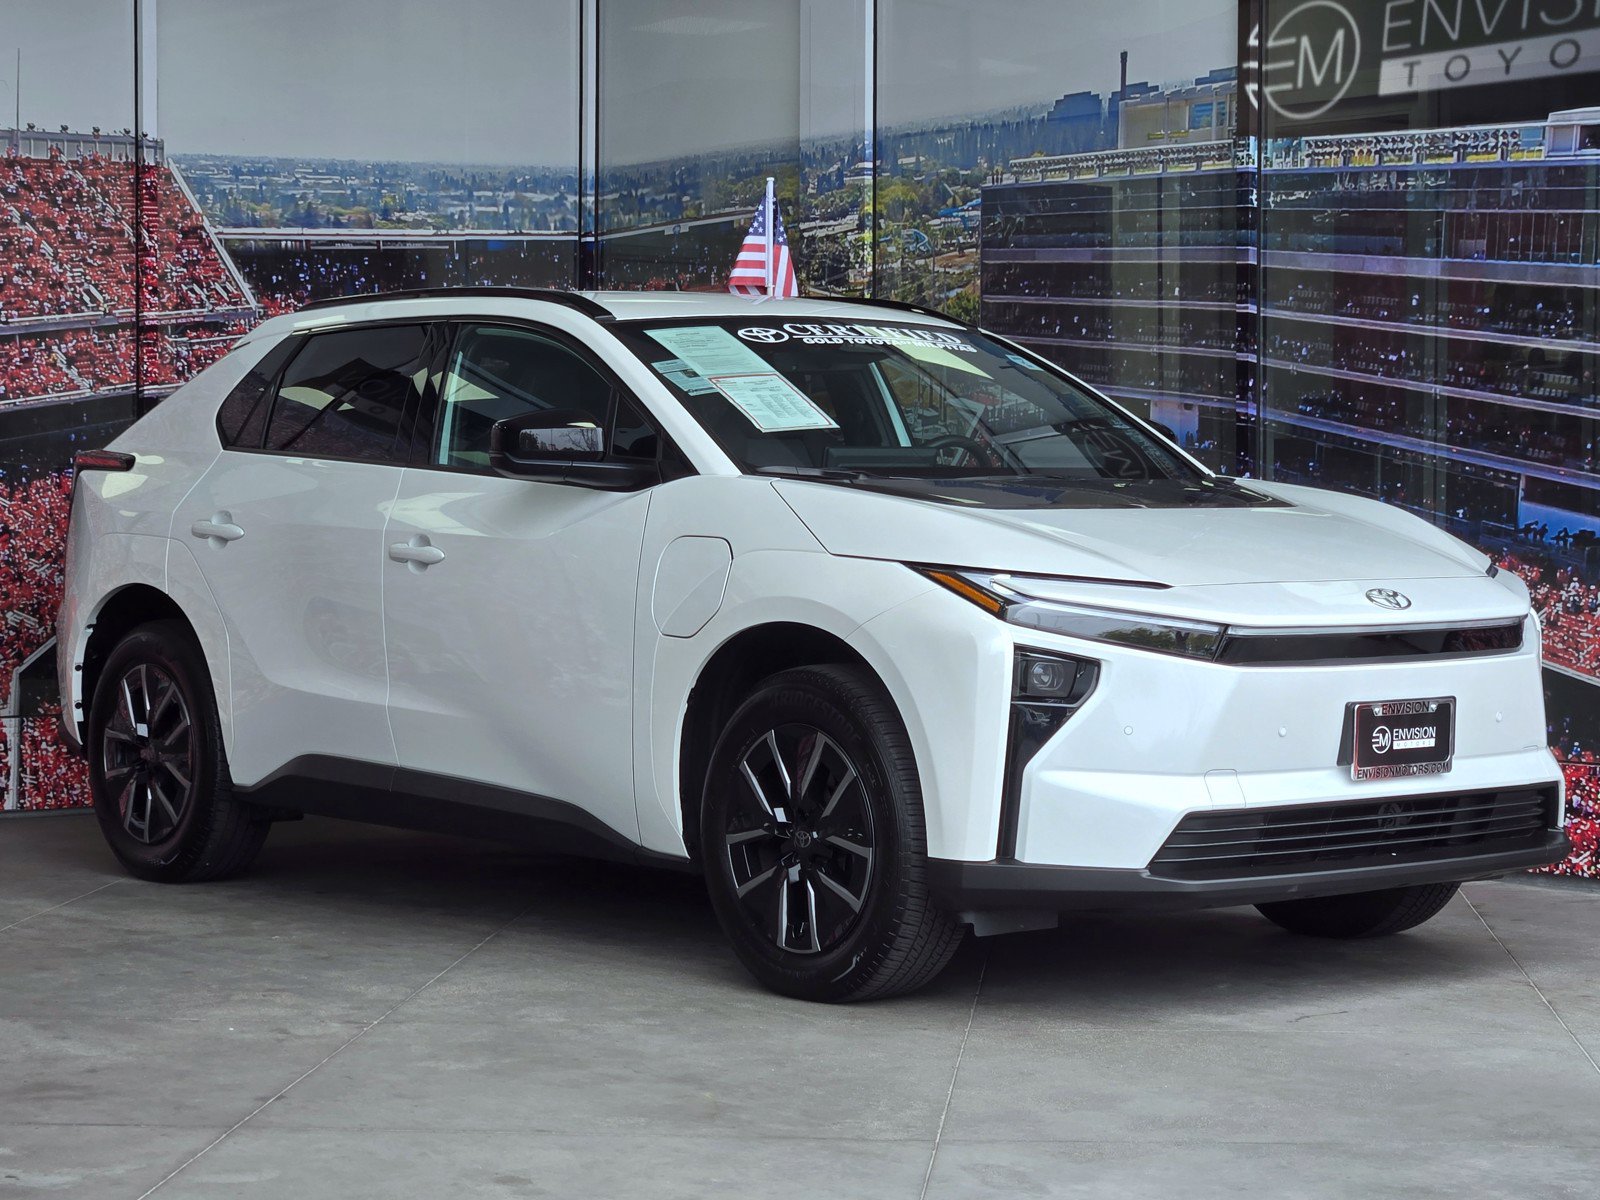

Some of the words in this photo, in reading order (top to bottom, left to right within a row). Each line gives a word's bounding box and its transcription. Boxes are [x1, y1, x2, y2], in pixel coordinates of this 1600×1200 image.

[1403, 38, 1581, 87] TOYO
[782, 323, 961, 343] CERTIFIED
[802, 337, 844, 345] GOLD
[846, 338, 900, 346] TOYOTA
[913, 340, 978, 353] MILPITAS
[1382, 701, 1430, 715] ENVISION
[1393, 727, 1436, 740] ENVISION
[1357, 762, 1449, 779] ENVISIONMOTORS.COM
